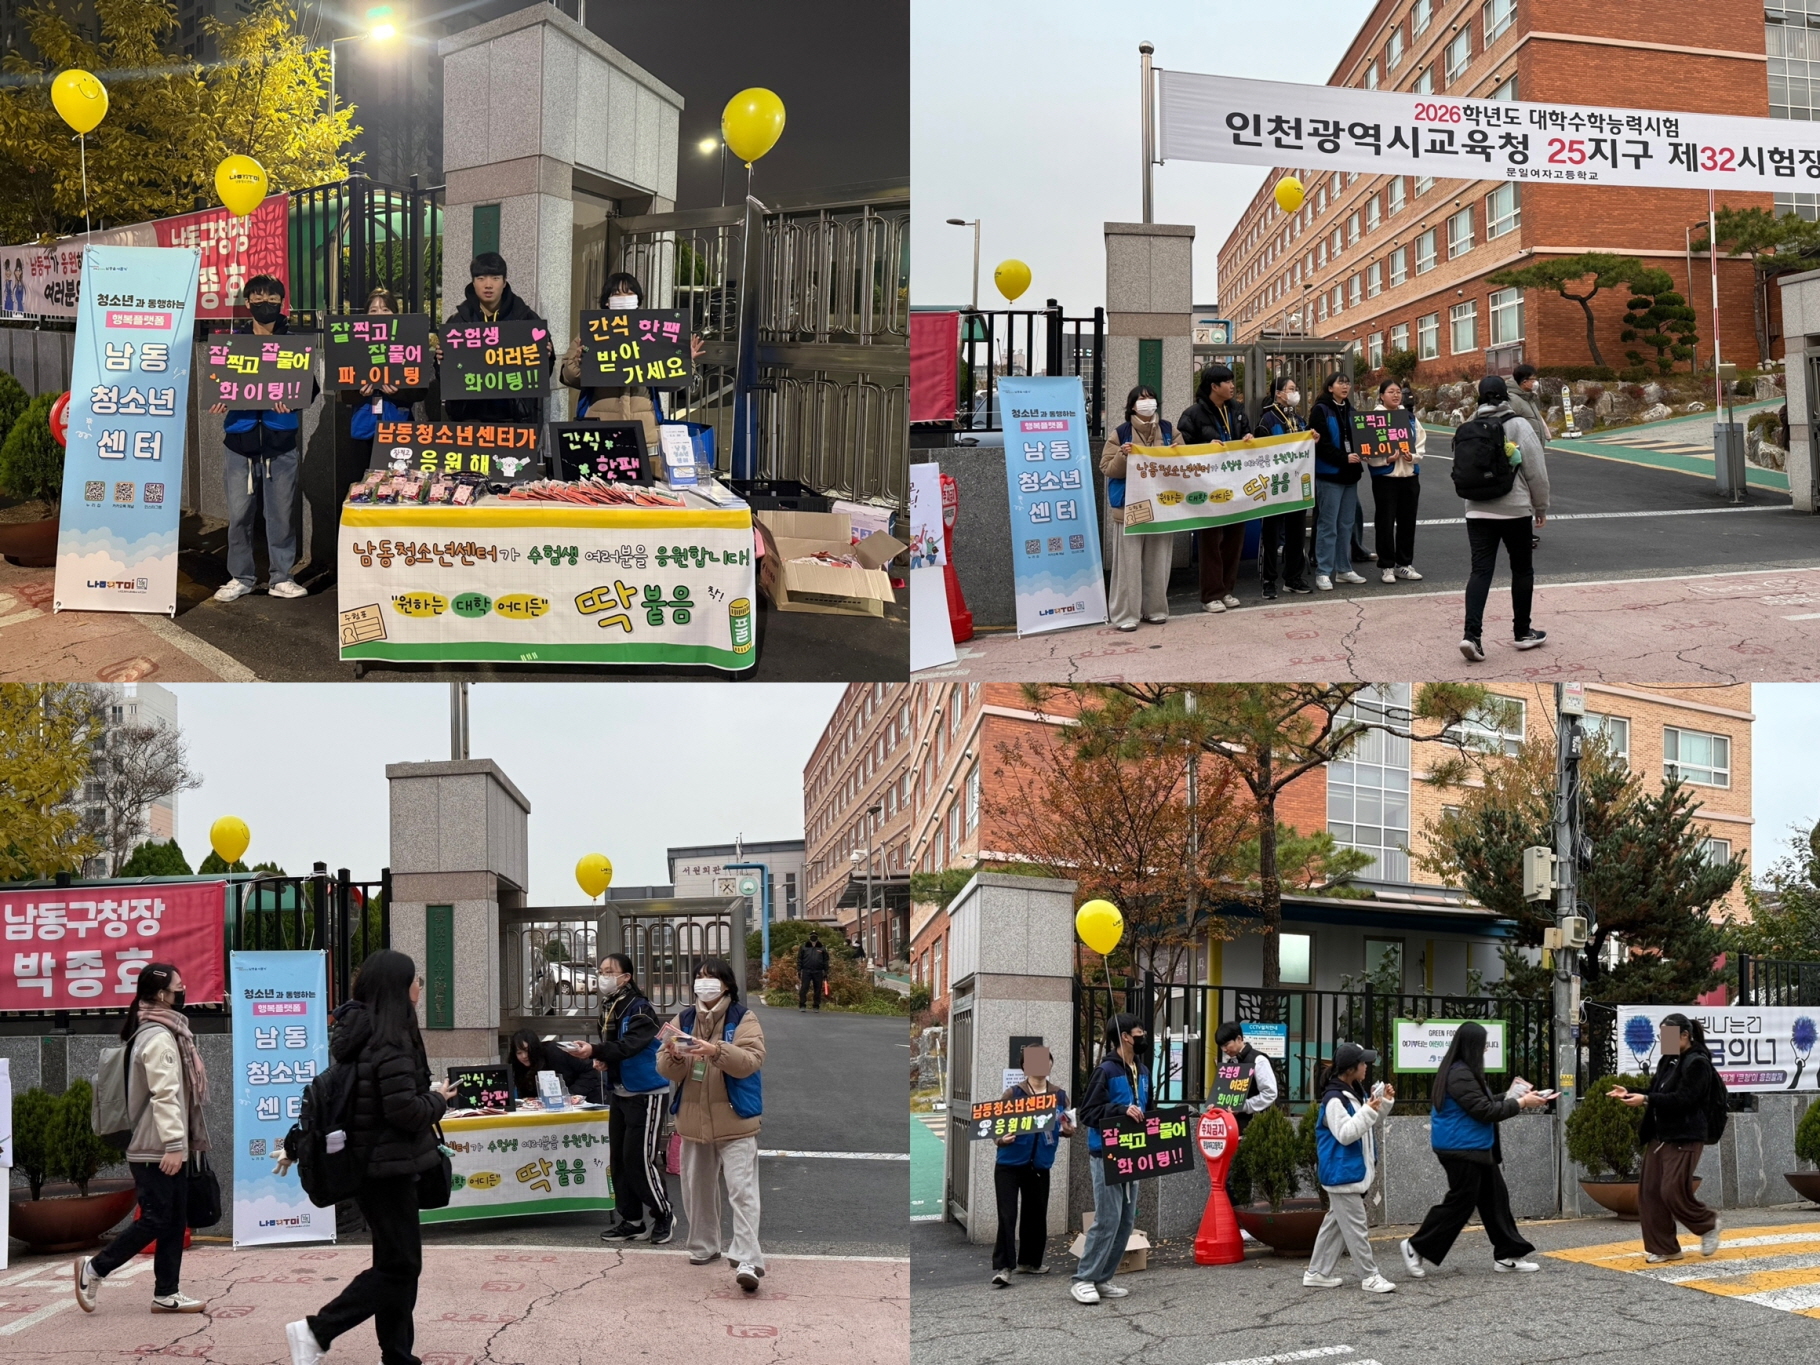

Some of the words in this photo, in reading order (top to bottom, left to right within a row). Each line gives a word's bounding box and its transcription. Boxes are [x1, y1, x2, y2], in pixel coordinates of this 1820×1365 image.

[1414, 102, 1522, 128] 2026학년도
[1529, 109, 1680, 138] 대학수학능력시험
[1225, 111, 1530, 165] 인천광역시교육청
[1547, 136, 1653, 169] 25지구
[1668, 141, 1820, 178] 제32시험장
[1506, 167, 1599, 180] 문일여자고등학교
[171, 217, 251, 255] 남동구청장
[30, 253, 59, 277] 남동구가
[148, 298, 185, 310] 동행하는
[112, 313, 165, 326] 행복플랫폼
[588, 315, 629, 342] 간식
[638, 319, 681, 343] 핫팩
[446, 326, 500, 349] 수험생
[484, 343, 541, 366] 여러분
[597, 341, 640, 373] 받아
[464, 369, 539, 392] 화이팅!!
[623, 356, 687, 385] 가세요
[90, 384, 177, 416] 청소년
[377, 421, 537, 450] 남동청소년센터가
[562, 431, 601, 452] 간식
[596, 456, 640, 480] 핫팩
[1221, 459, 1242, 472] 수험생
[1018, 467, 1082, 493] 청소년
[1242, 473, 1270, 502] 딱
[1188, 492, 1208, 503] 대학
[527, 544, 579, 567] 수험생
[584, 544, 648, 569] 여러분을
[655, 546, 750, 568] 응원합니다!
[391, 595, 444, 615] "원하는
[456, 596, 491, 615] 대학
[498, 598, 548, 617] 어디든"
[575, 579, 637, 633] 딱
[641, 584, 694, 627] 붙음
[4, 898, 166, 941] 남동구청장
[13, 947, 154, 998] 박종효
[257, 1003, 301, 1014] 행복플랫폼
[1428, 1029, 1445, 1037] GREEN
[246, 1059, 317, 1086] 청소년
[459, 1072, 485, 1088] 간식
[1218, 1065, 1241, 1079] 수험생
[1229, 1077, 1250, 1092] 여러분
[480, 1089, 509, 1107] 핫팩
[972, 1093, 1057, 1120] 남동청소년센터가
[1201, 1123, 1225, 1136] 주차금지
[487, 1138, 519, 1153] 수험생
[521, 1134, 559, 1151] 여러분을
[515, 1157, 553, 1192] 딱
[555, 1158, 587, 1187] 붙음
